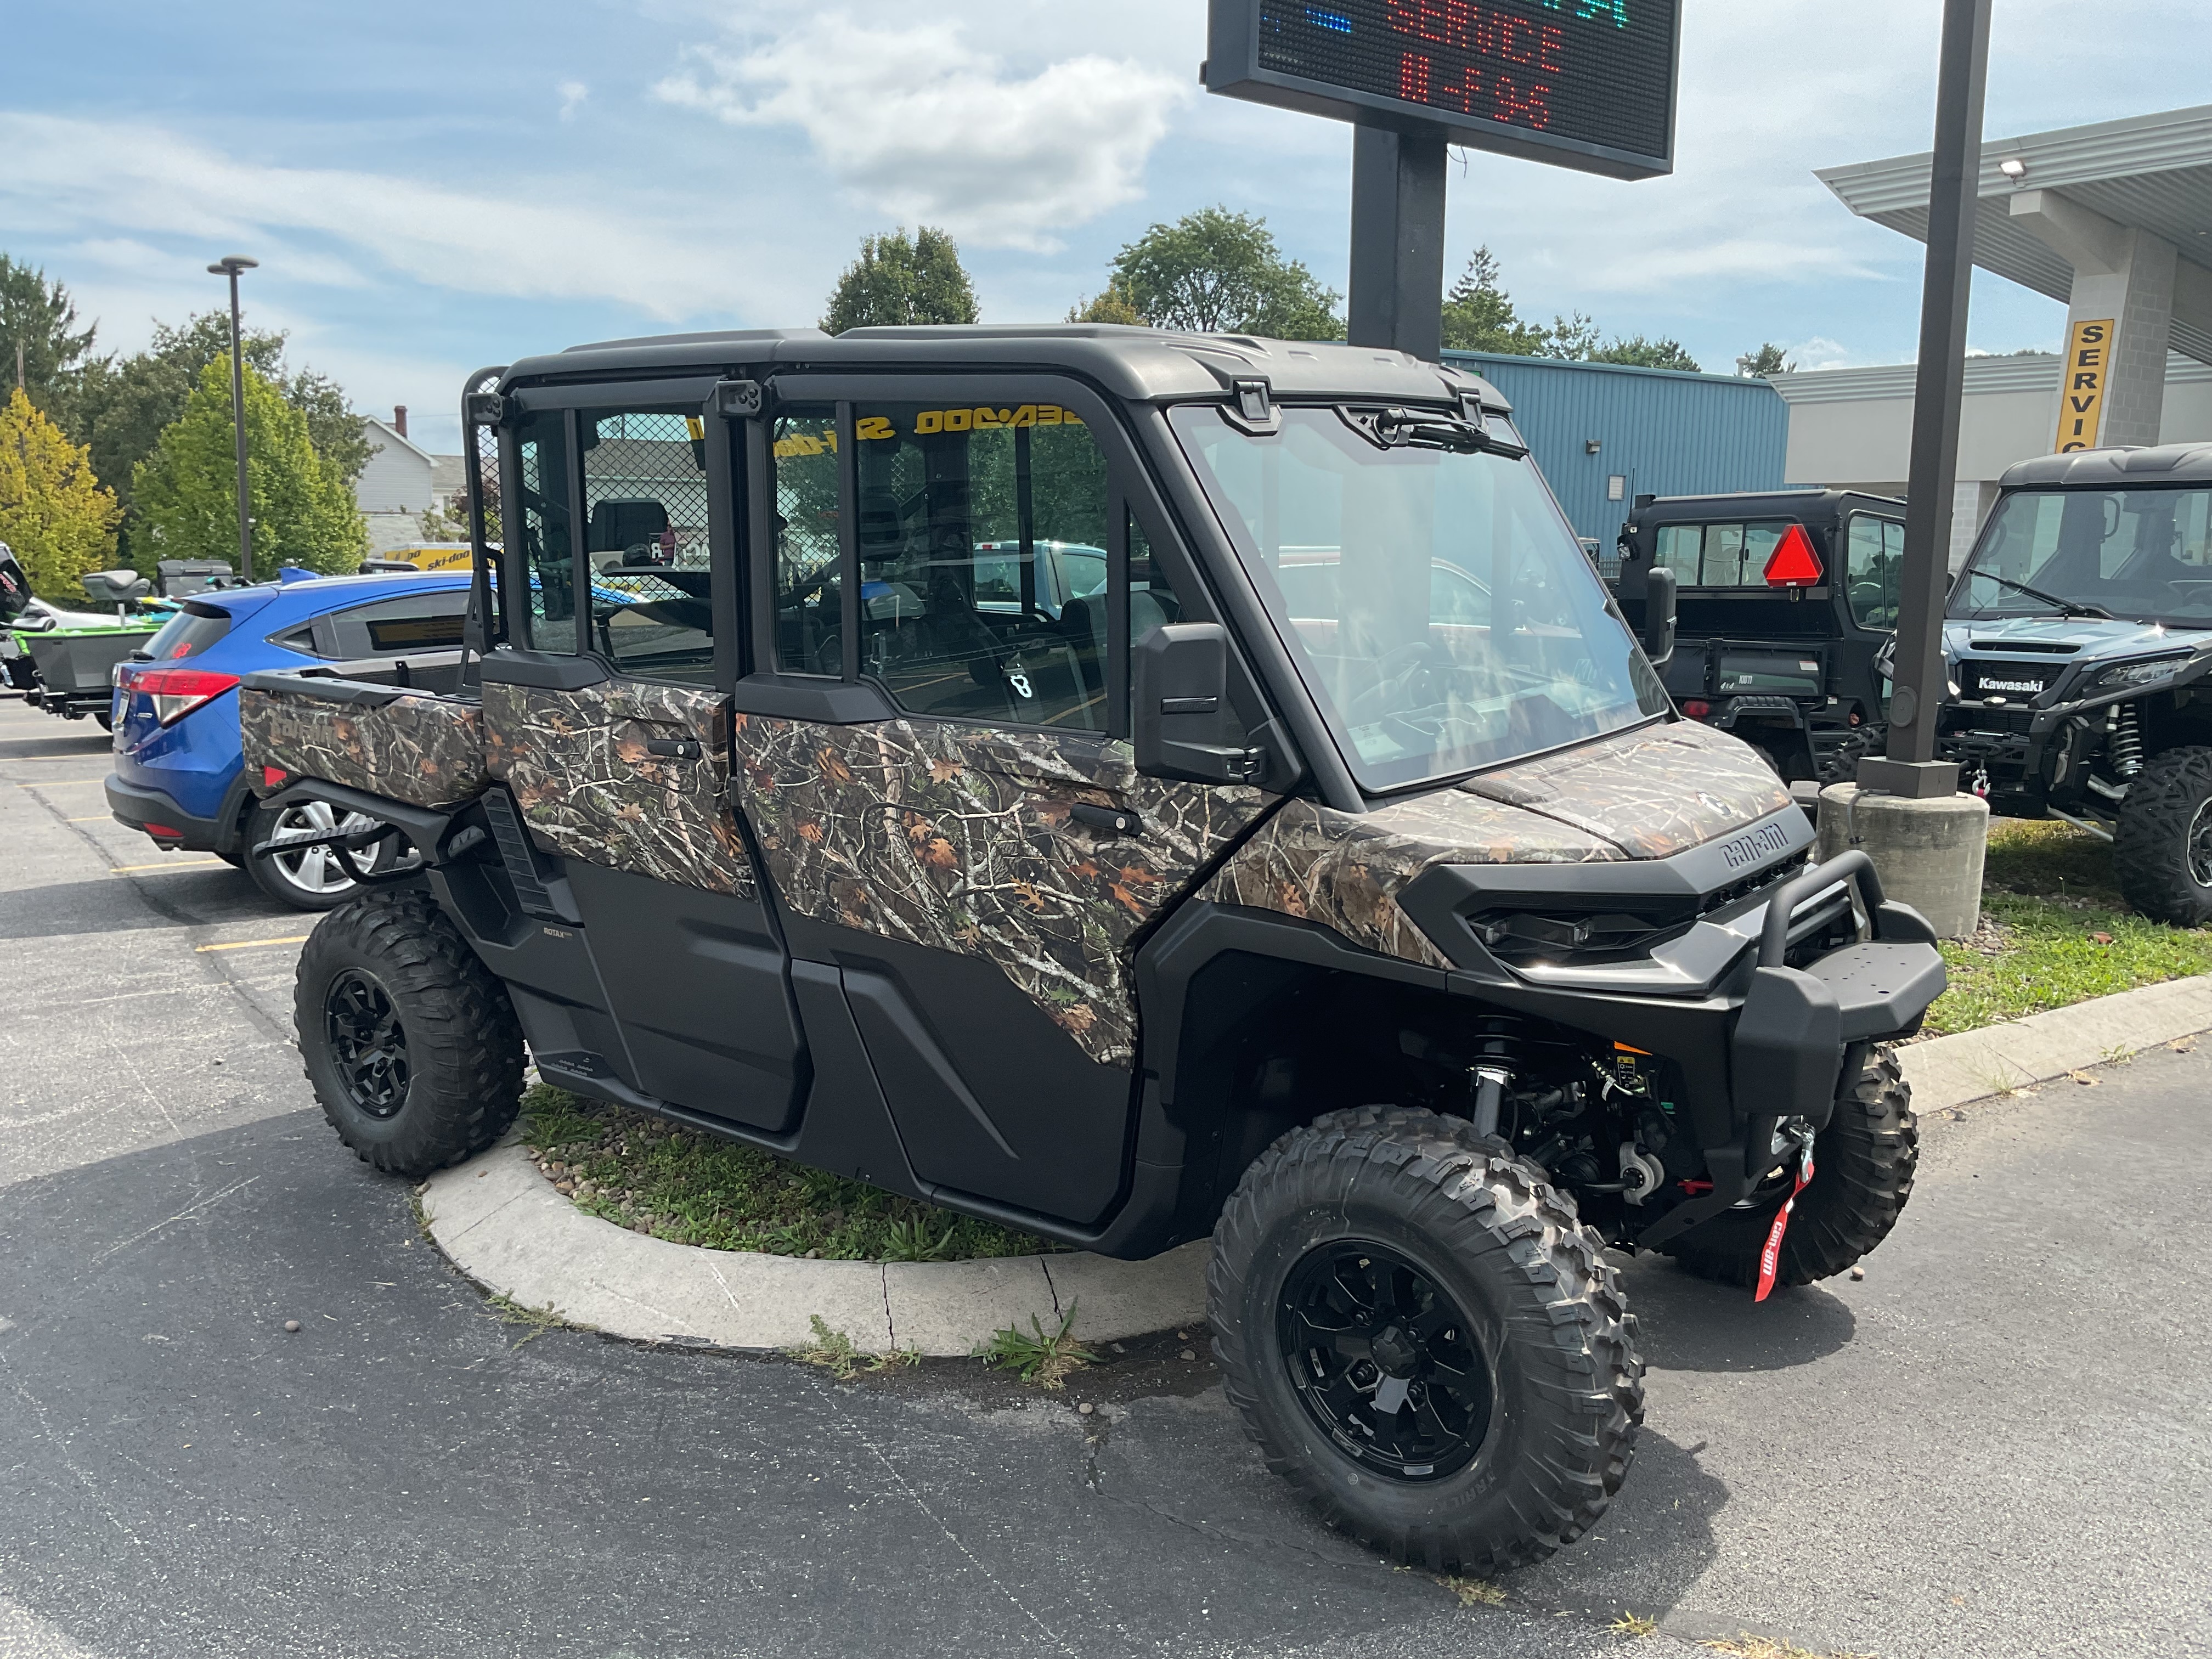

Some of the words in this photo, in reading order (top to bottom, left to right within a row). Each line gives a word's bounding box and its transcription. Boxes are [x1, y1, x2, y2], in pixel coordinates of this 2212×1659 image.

[427, 550, 470, 571] ski-doo
[1978, 677, 2044, 692] Kawasaki
[544, 927, 565, 938] ROTAX
[1763, 1221, 1782, 1276] can-am
